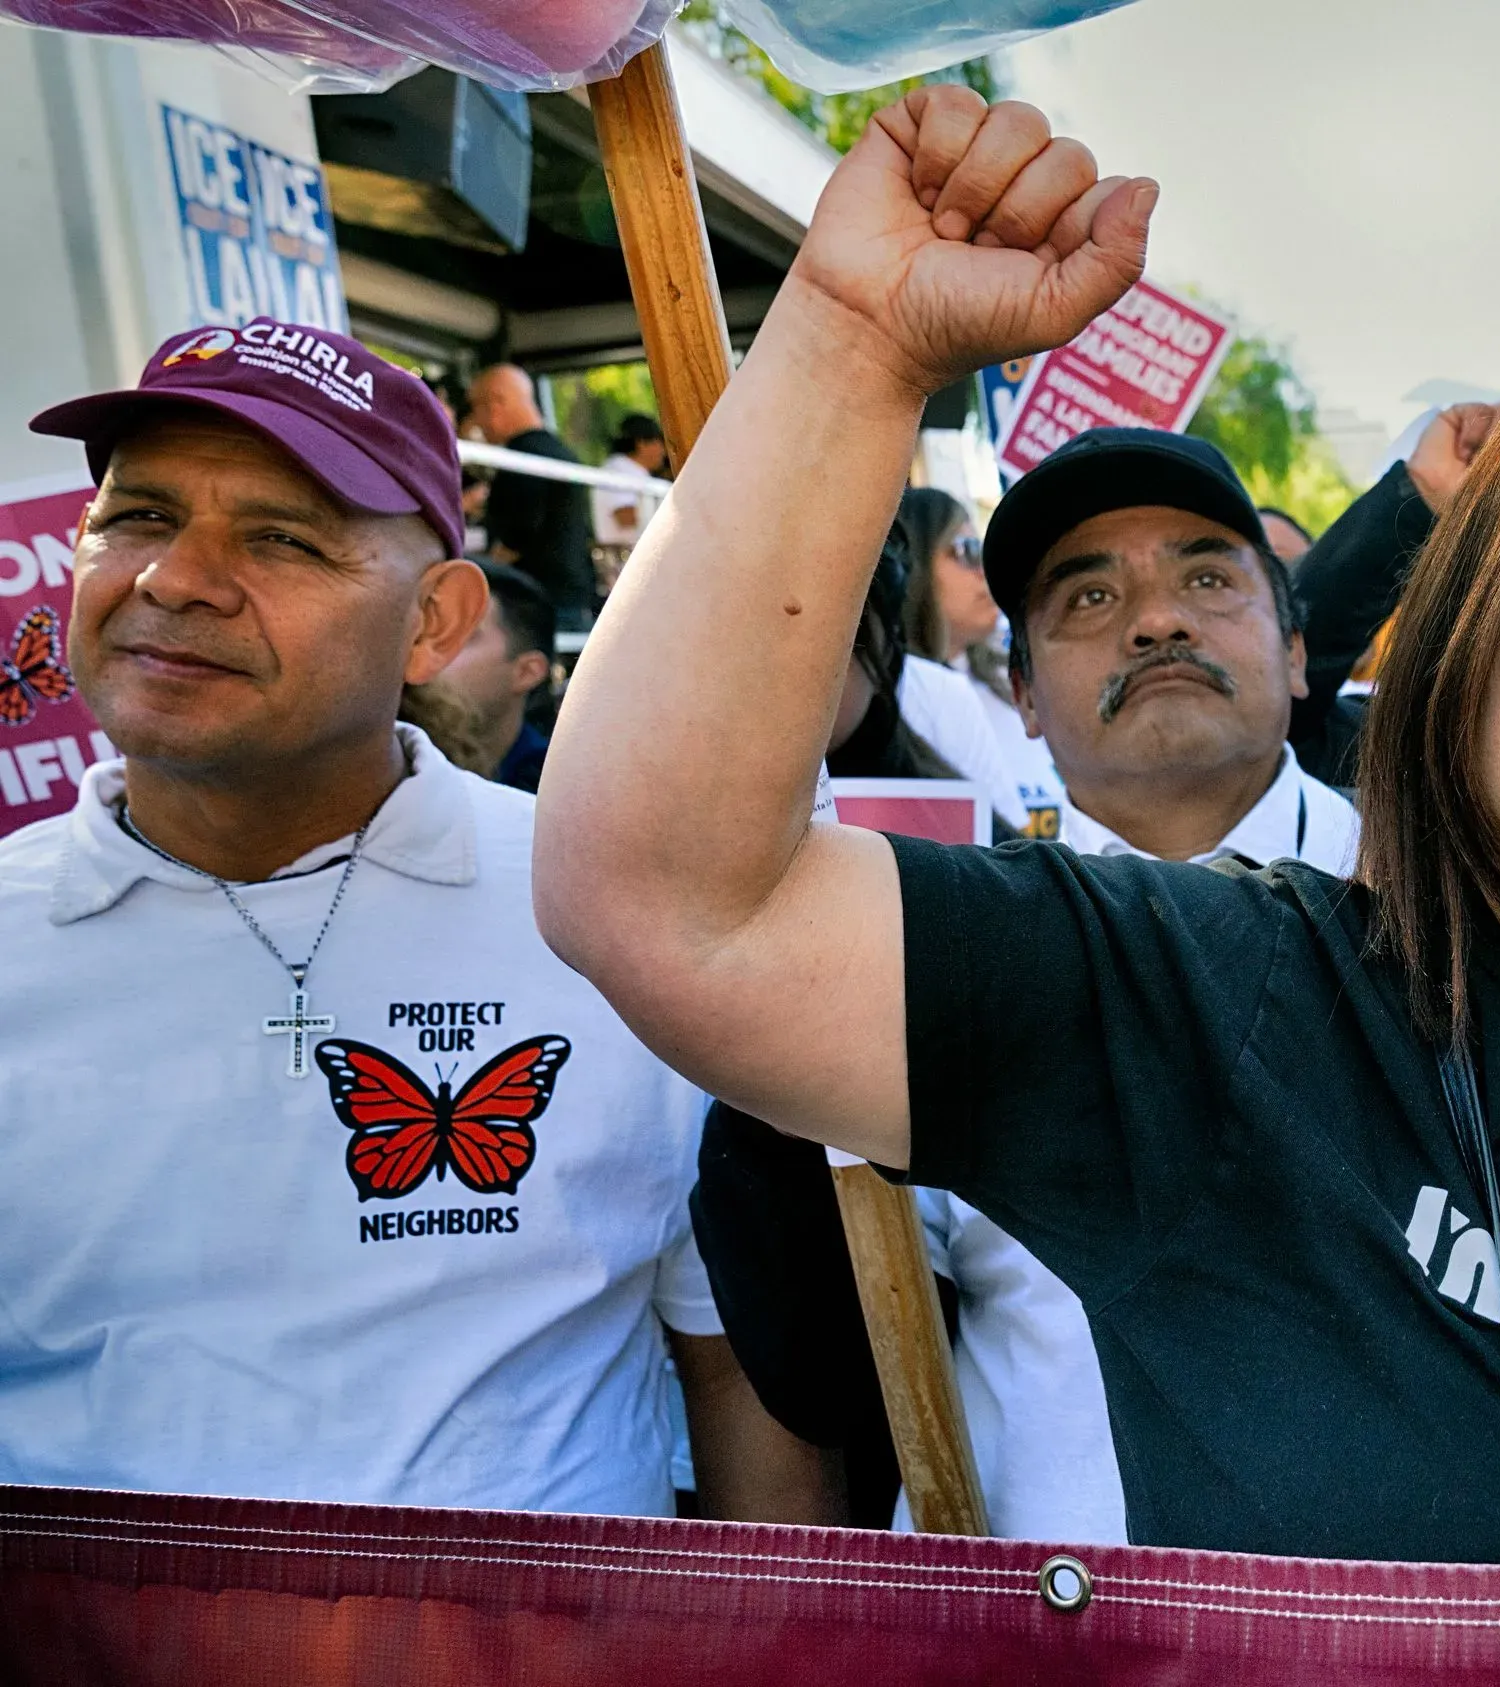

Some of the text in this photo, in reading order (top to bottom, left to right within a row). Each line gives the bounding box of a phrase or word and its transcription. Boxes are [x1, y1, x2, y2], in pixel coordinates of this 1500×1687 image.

[233, 344, 300, 366] Coalition
[301, 360, 321, 376] for
[238, 354, 317, 387] Immigrant
[241, 324, 373, 400] CHIRLA
[389, 1002, 505, 1027] PROTECT
[418, 1028, 475, 1052] OUR
[359, 1206, 519, 1244] NEIGHBORS
